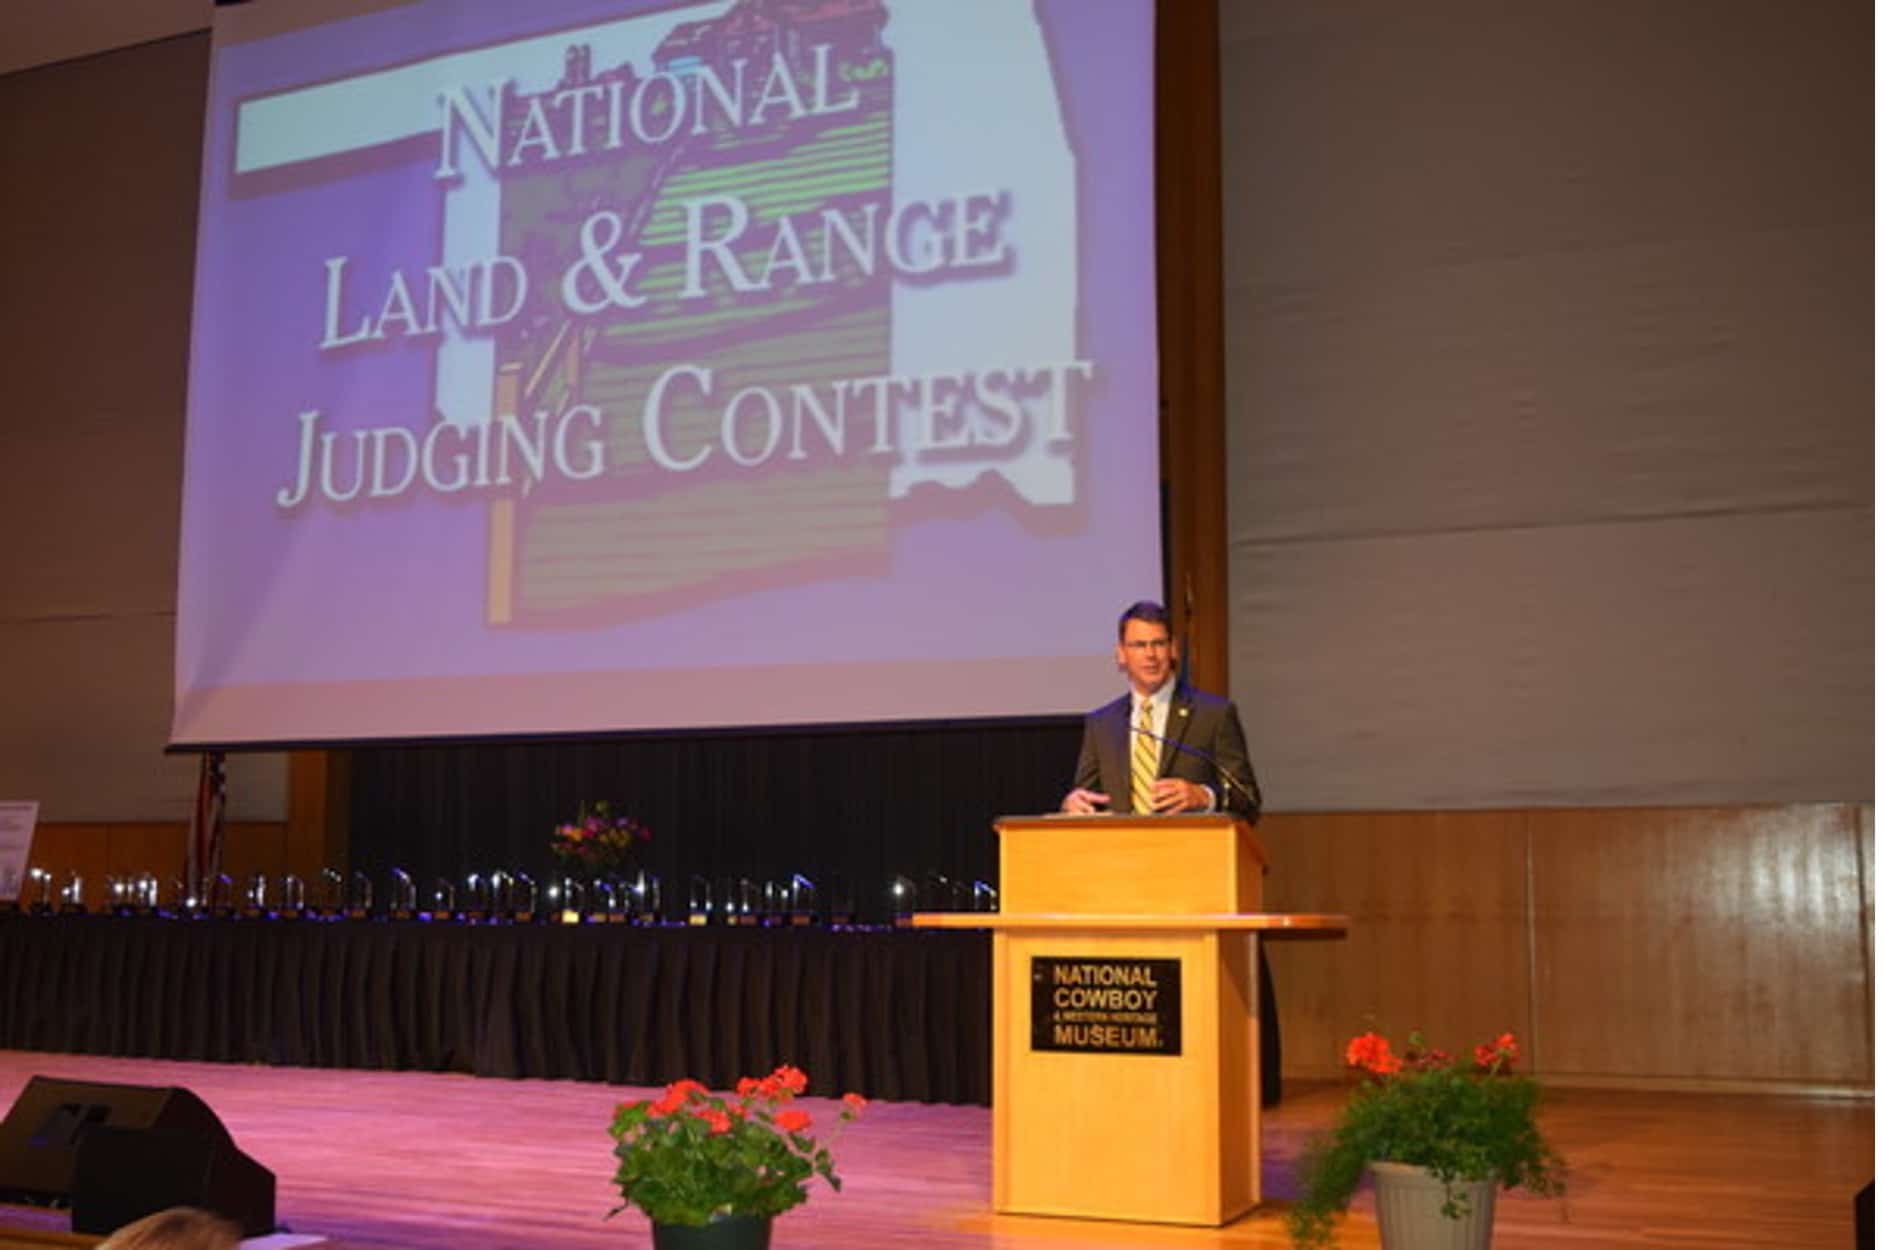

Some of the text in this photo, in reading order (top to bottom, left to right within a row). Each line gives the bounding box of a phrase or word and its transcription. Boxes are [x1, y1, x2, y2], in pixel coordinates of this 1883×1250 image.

[434, 44, 859, 180] NATIONAL
[318, 192, 1012, 350] LAND & RANGE
[276, 359, 1093, 508] JUDGING CONTEST
[1054, 988, 1157, 1010] COWBOY
[1055, 965, 1157, 986] NATIONAL
